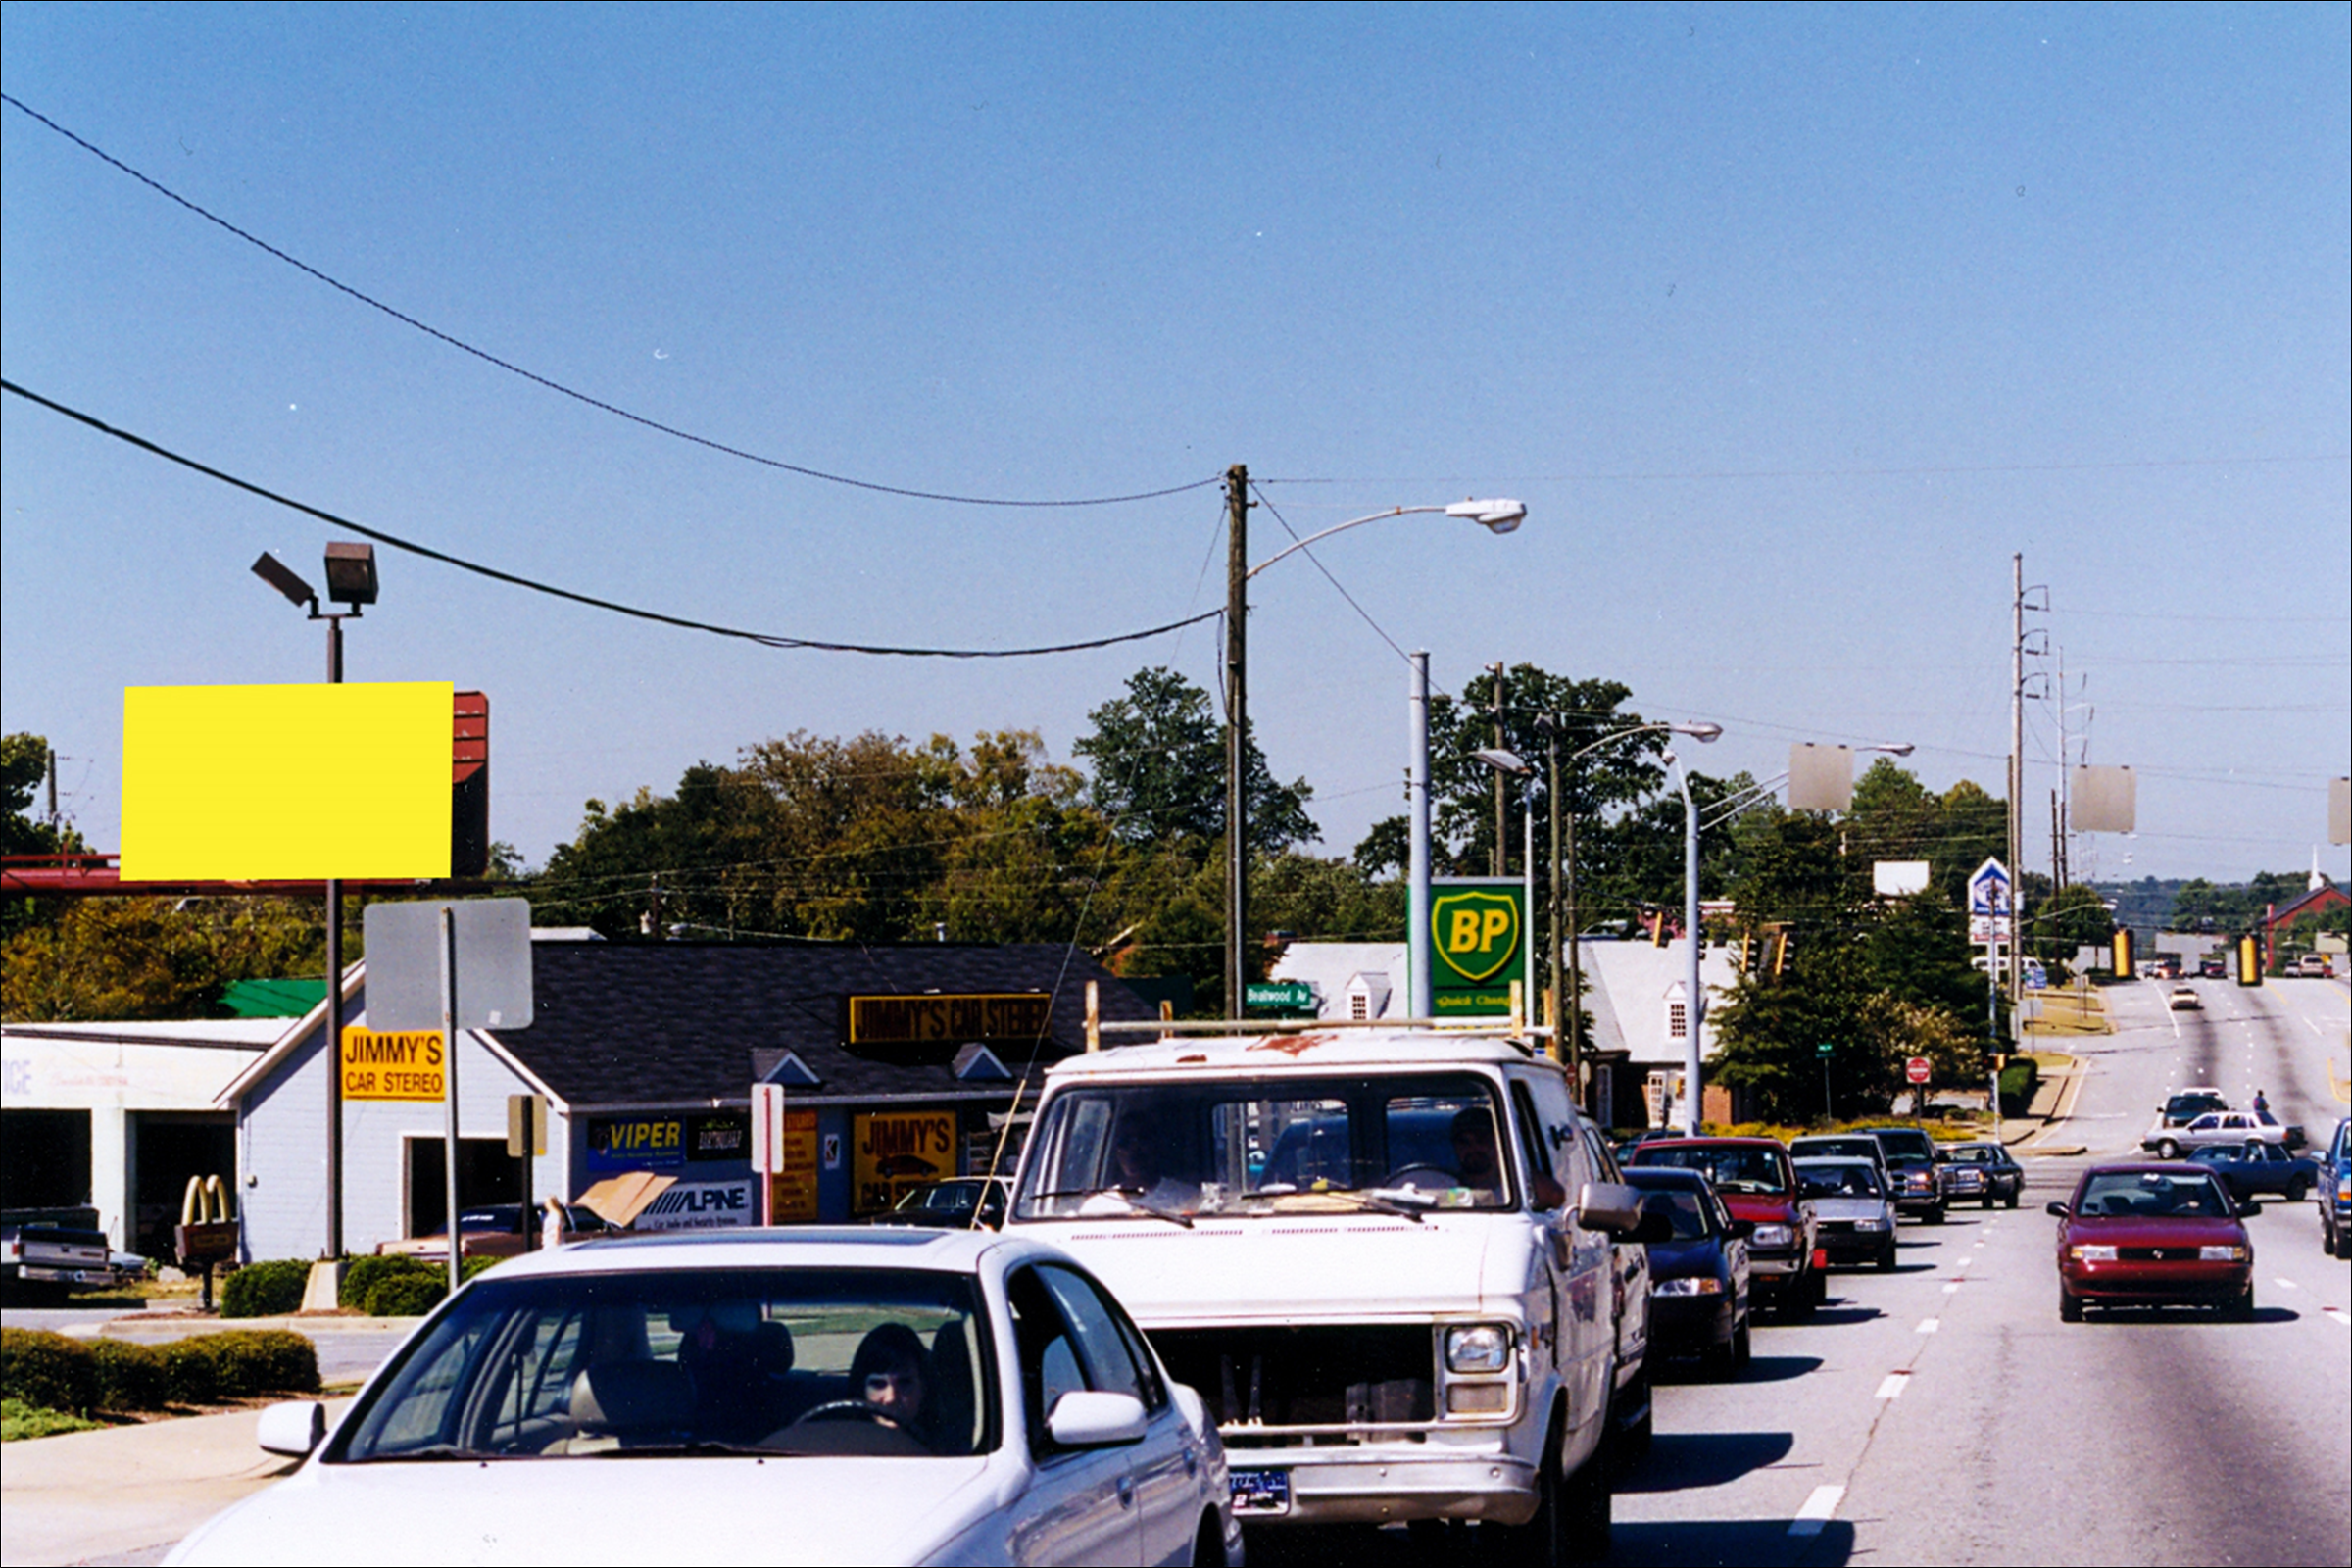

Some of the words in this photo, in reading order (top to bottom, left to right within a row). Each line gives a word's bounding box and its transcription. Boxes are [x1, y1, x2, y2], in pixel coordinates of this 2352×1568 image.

[1447, 908, 1510, 953] BP
[1436, 994, 1472, 1008] Quick
[1475, 994, 1510, 1008] Chang
[856, 999, 947, 1039] JIMMY'S
[950, 998, 982, 1038] CAR
[345, 1035, 443, 1065] JIMMY'S
[345, 1071, 376, 1092] CAR
[383, 1071, 443, 1094] STEREO
[610, 1121, 682, 1150] VIPER
[862, 1117, 950, 1155] JIMMY'S
